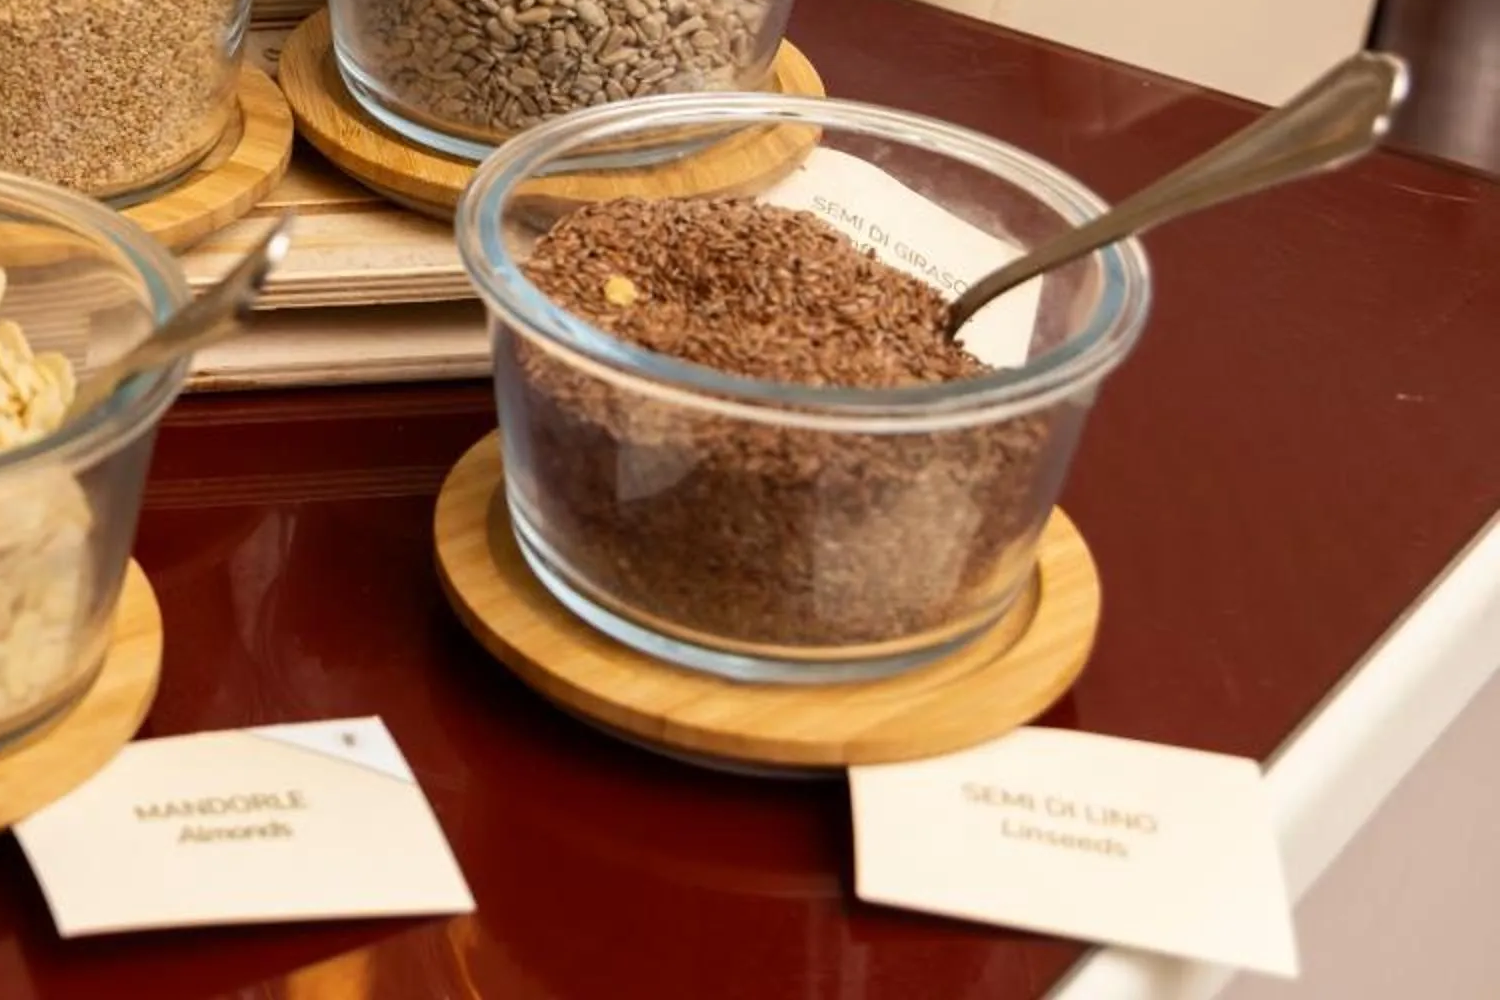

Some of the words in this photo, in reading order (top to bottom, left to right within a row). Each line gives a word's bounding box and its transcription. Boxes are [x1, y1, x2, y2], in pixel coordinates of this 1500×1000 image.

[812, 194, 864, 231] SEMI
[868, 224, 890, 247] DI
[894, 241, 970, 296] GIRASO
[133, 789, 306, 822] MANDORLE
[961, 781, 1036, 813] SEMI
[1045, 795, 1077, 819] DI
[1084, 804, 1158, 835] LINO
[177, 821, 294, 845] Almonds
[1000, 817, 1129, 860] Linseeds
